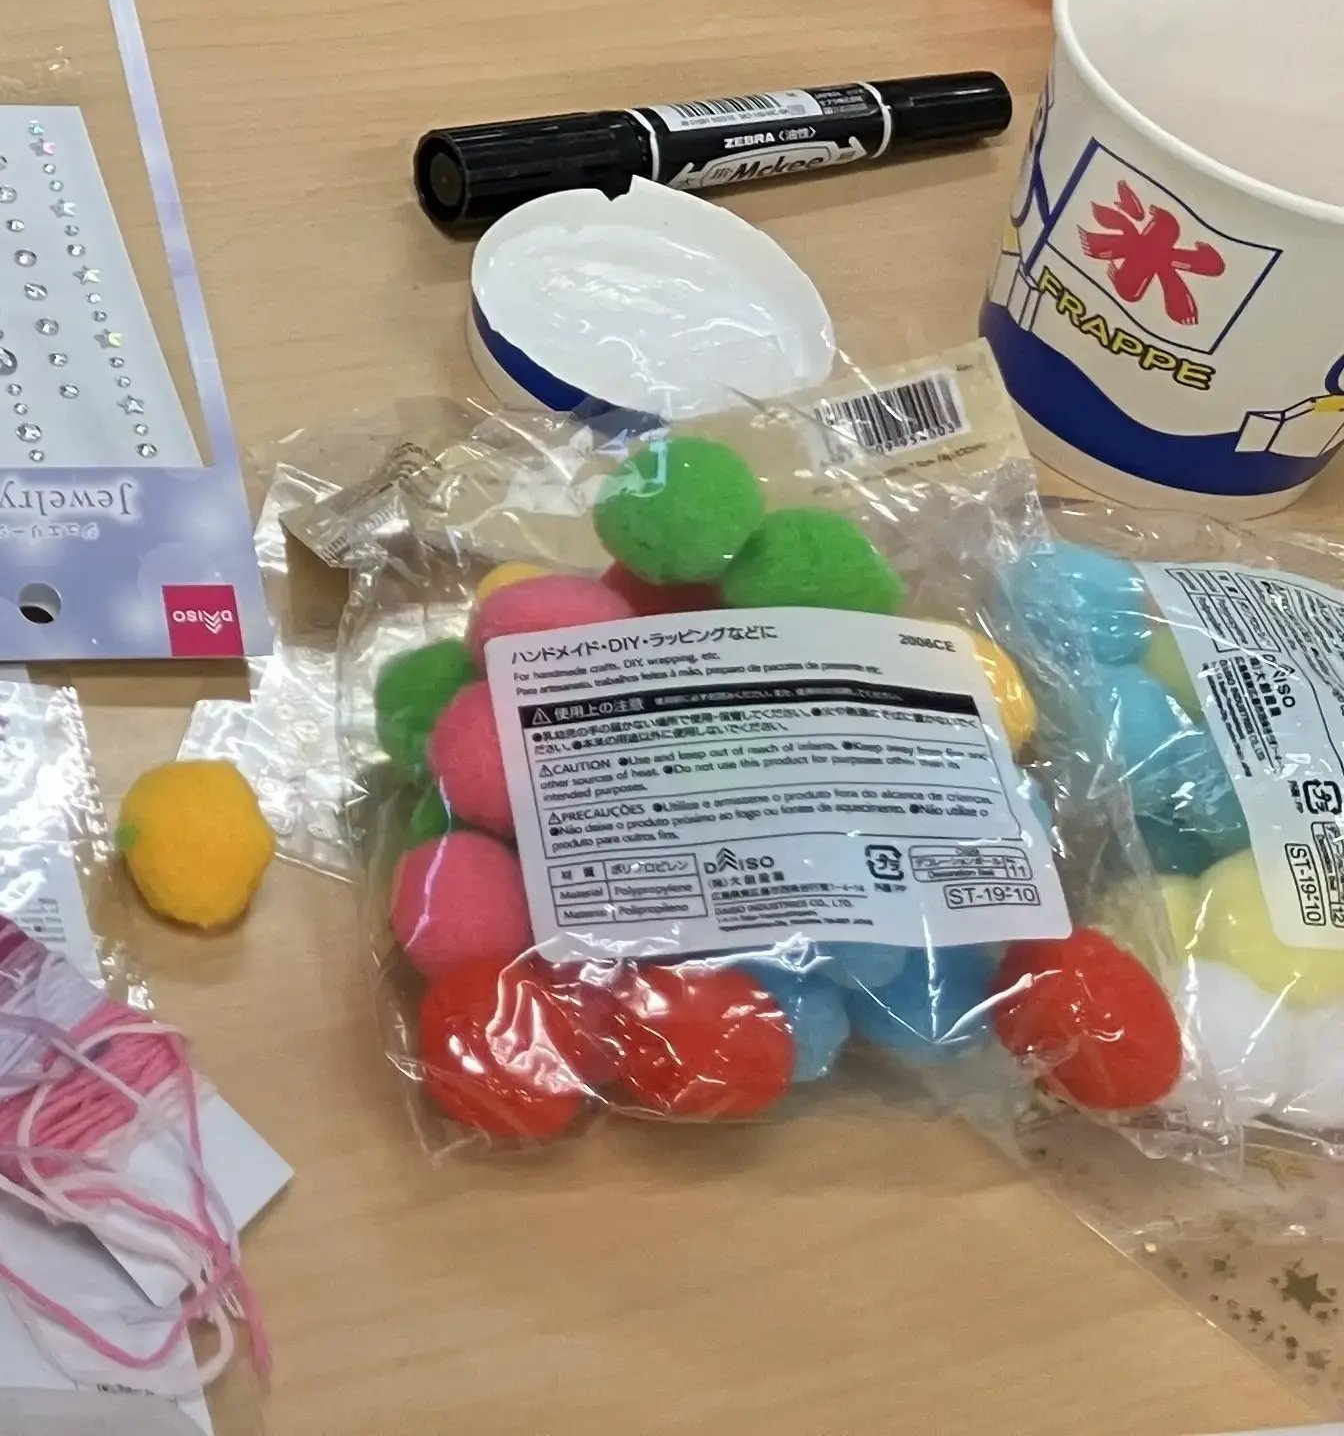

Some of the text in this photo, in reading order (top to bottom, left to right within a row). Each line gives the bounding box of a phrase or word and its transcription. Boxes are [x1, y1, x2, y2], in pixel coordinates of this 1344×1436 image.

[723, 131, 776, 150] ZEBRA
[1077, 180, 1226, 326] 氷
[1036, 265, 1216, 391] FRAPPE
[172, 609, 234, 636] DAISO
[511, 625, 779, 665] ハンドメイド・DIY・ラッピングなどに
[513, 672, 530, 681] For
[533, 666, 588, 679] handmade
[554, 697, 645, 722] 使用上の注意
[552, 757, 612, 776] CAUTION
[710, 746, 730, 757] out
[561, 802, 646, 822] PRECAUÇÕES
[703, 846, 775, 875] DAISO
[559, 882, 693, 900] Material Polypropylene
